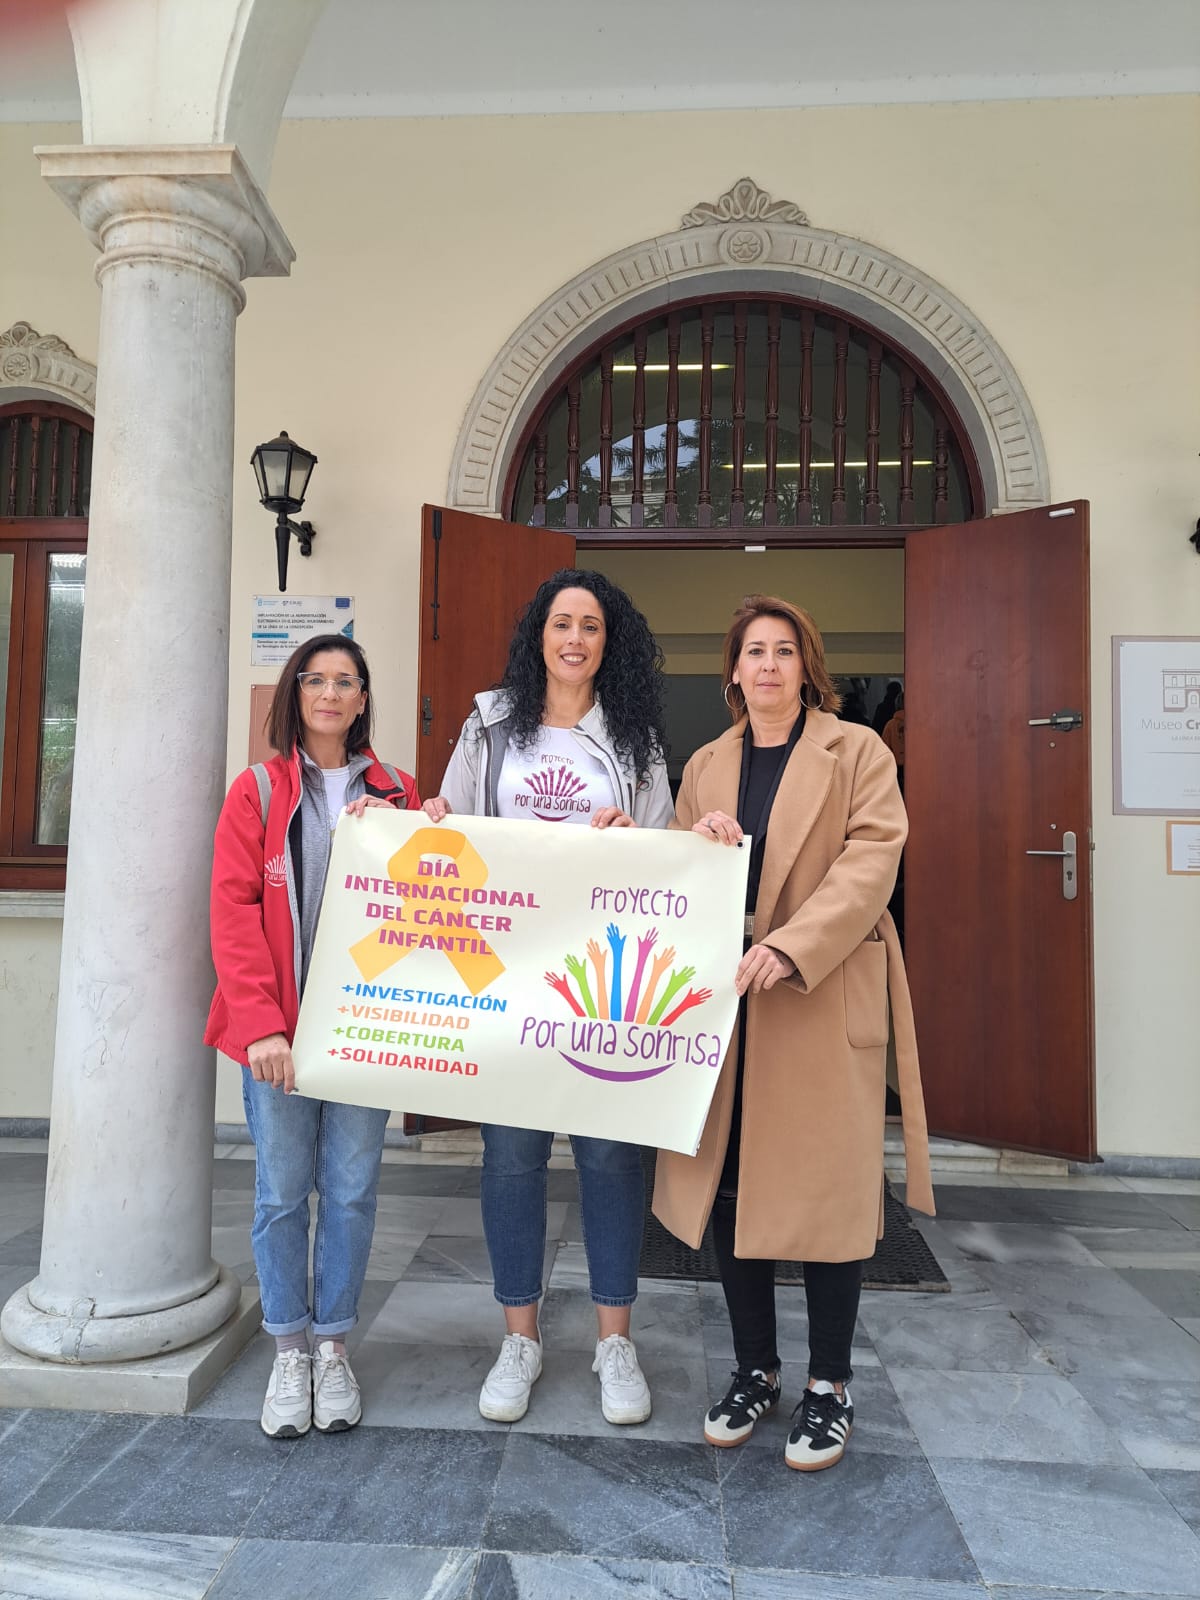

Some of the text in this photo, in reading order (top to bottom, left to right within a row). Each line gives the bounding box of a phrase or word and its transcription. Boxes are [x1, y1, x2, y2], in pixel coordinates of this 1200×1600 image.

[1141, 719, 1183, 730] Museo
[514, 793, 591, 813] Por una sonrisa
[417, 858, 460, 878] DÍA
[344, 874, 541, 909] INTERNACIONAL
[365, 902, 513, 933] DEL CÁNCER
[378, 928, 493, 956] INFANTIL
[520, 1016, 721, 1068] Por una sonrisa
